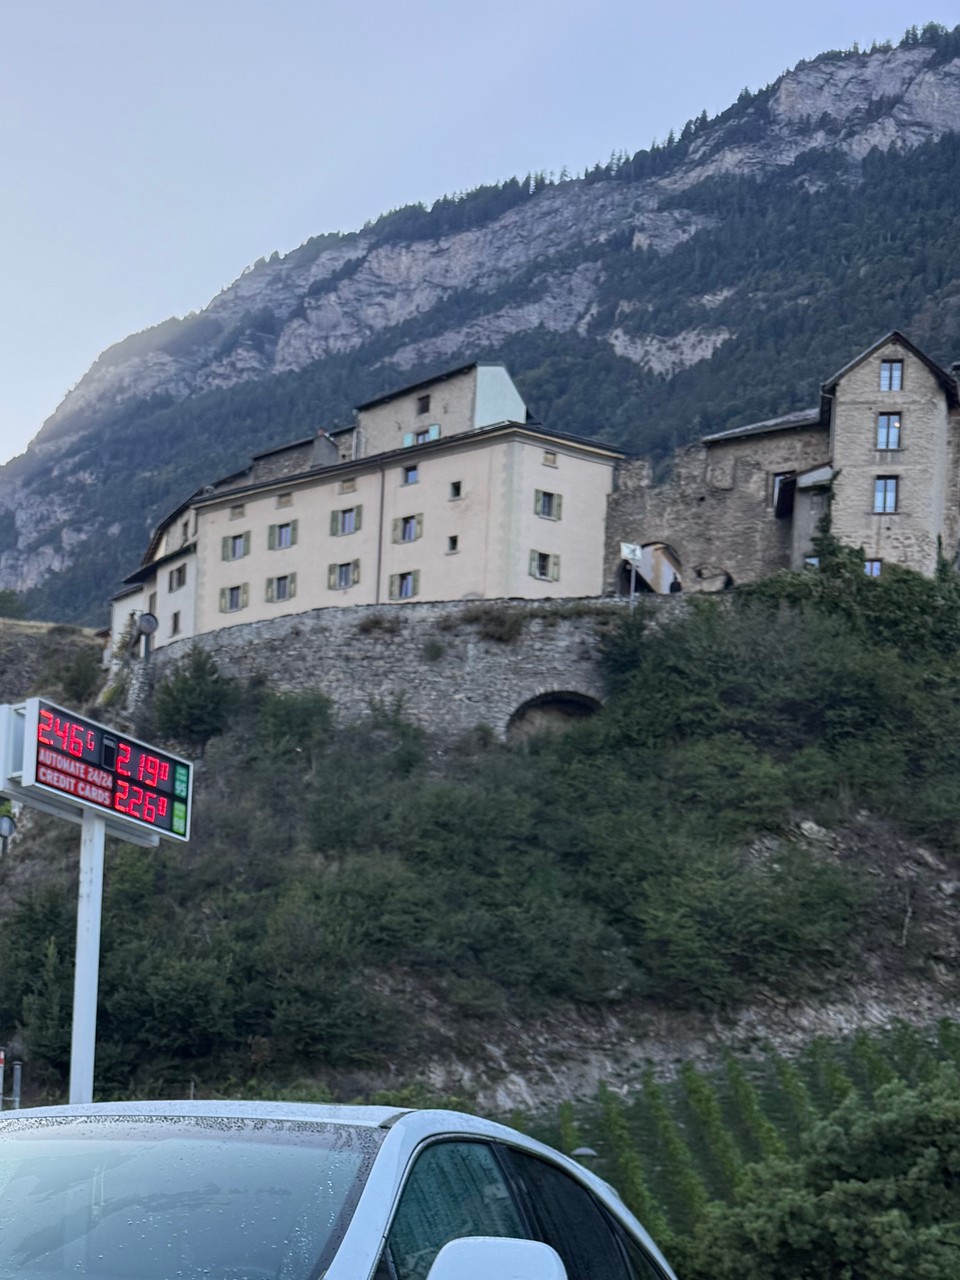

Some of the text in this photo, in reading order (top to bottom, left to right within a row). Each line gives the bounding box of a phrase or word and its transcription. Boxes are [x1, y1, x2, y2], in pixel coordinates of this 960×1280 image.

[39, 748, 113, 788] AUTOMATE 24/24
[39, 767, 111, 806] CREDIT CARDS
